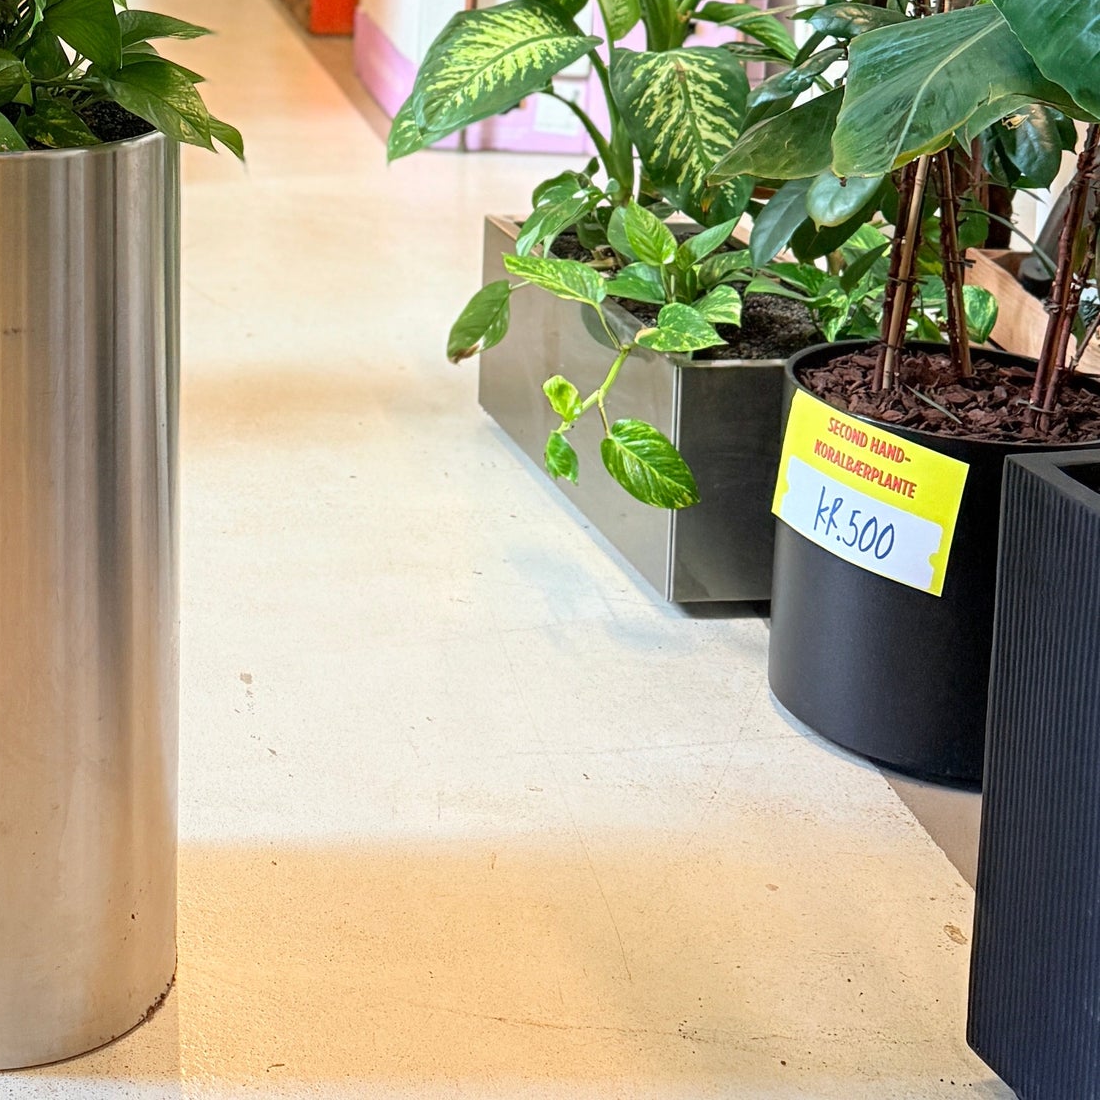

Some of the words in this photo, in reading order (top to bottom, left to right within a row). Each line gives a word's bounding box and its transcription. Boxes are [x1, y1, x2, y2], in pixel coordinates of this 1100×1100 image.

[827, 417, 868, 448] SECOND
[869, 436, 912, 464] HAND-
[813, 439, 917, 500] KORALBÆRPLANTE
